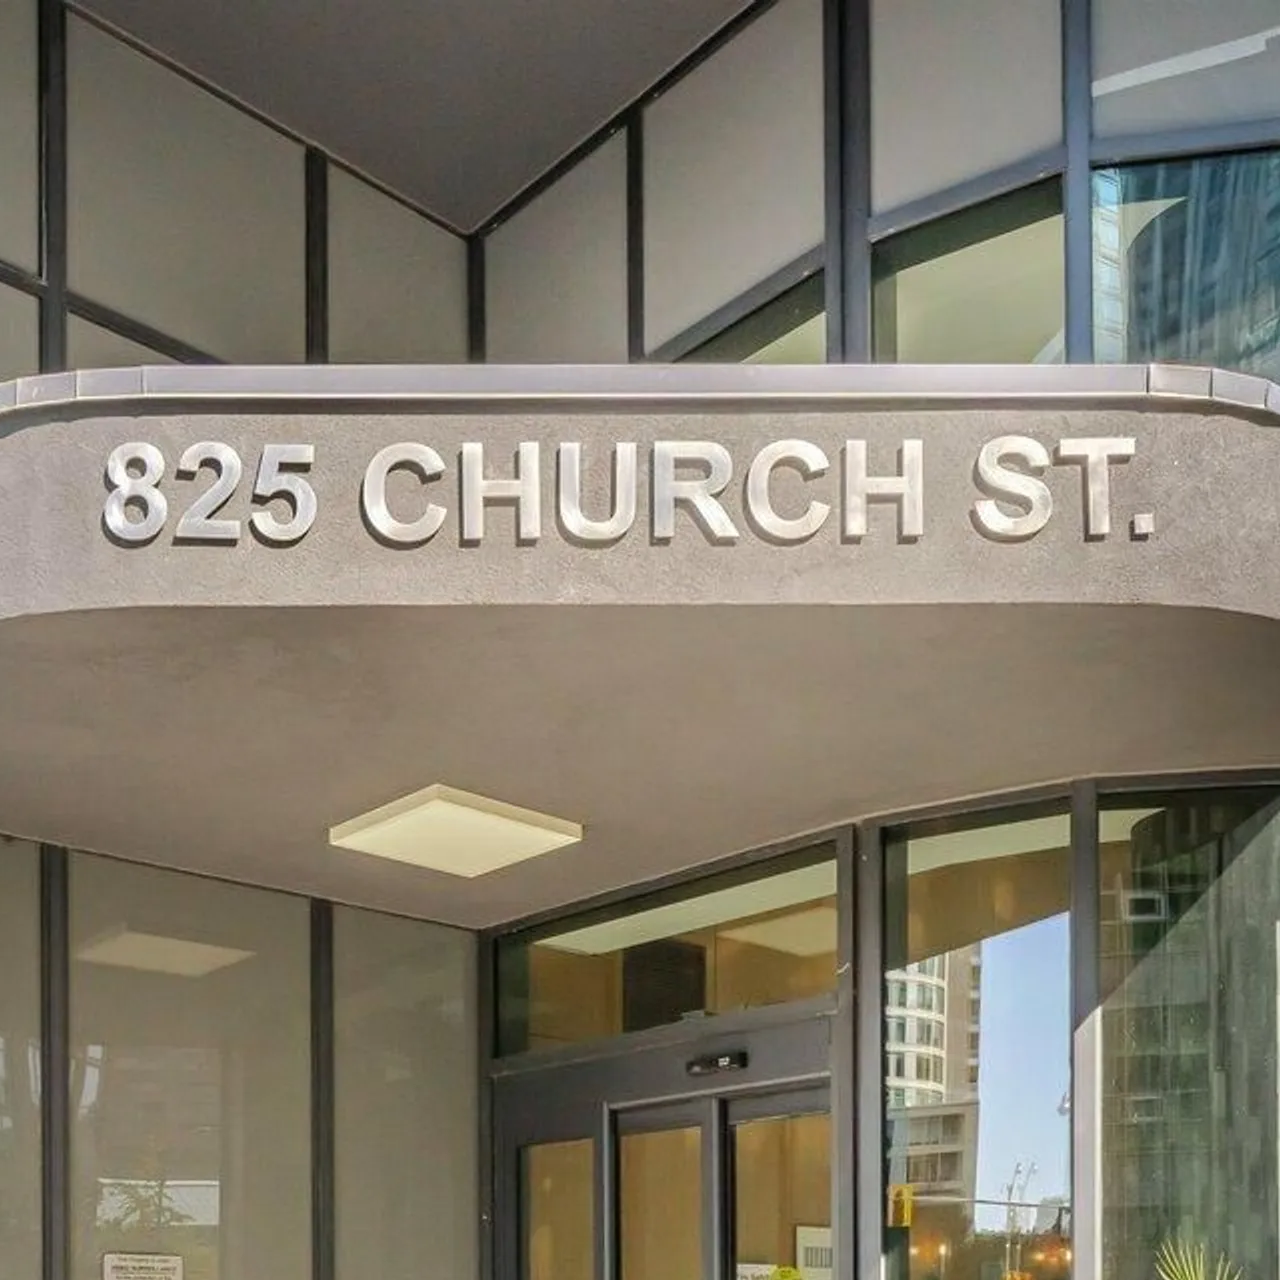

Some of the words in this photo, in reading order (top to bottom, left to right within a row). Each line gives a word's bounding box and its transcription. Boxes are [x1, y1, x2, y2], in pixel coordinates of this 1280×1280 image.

[102, 440, 318, 546] 825
[361, 439, 924, 546] CHURCH
[971, 435, 1155, 544] ST.
